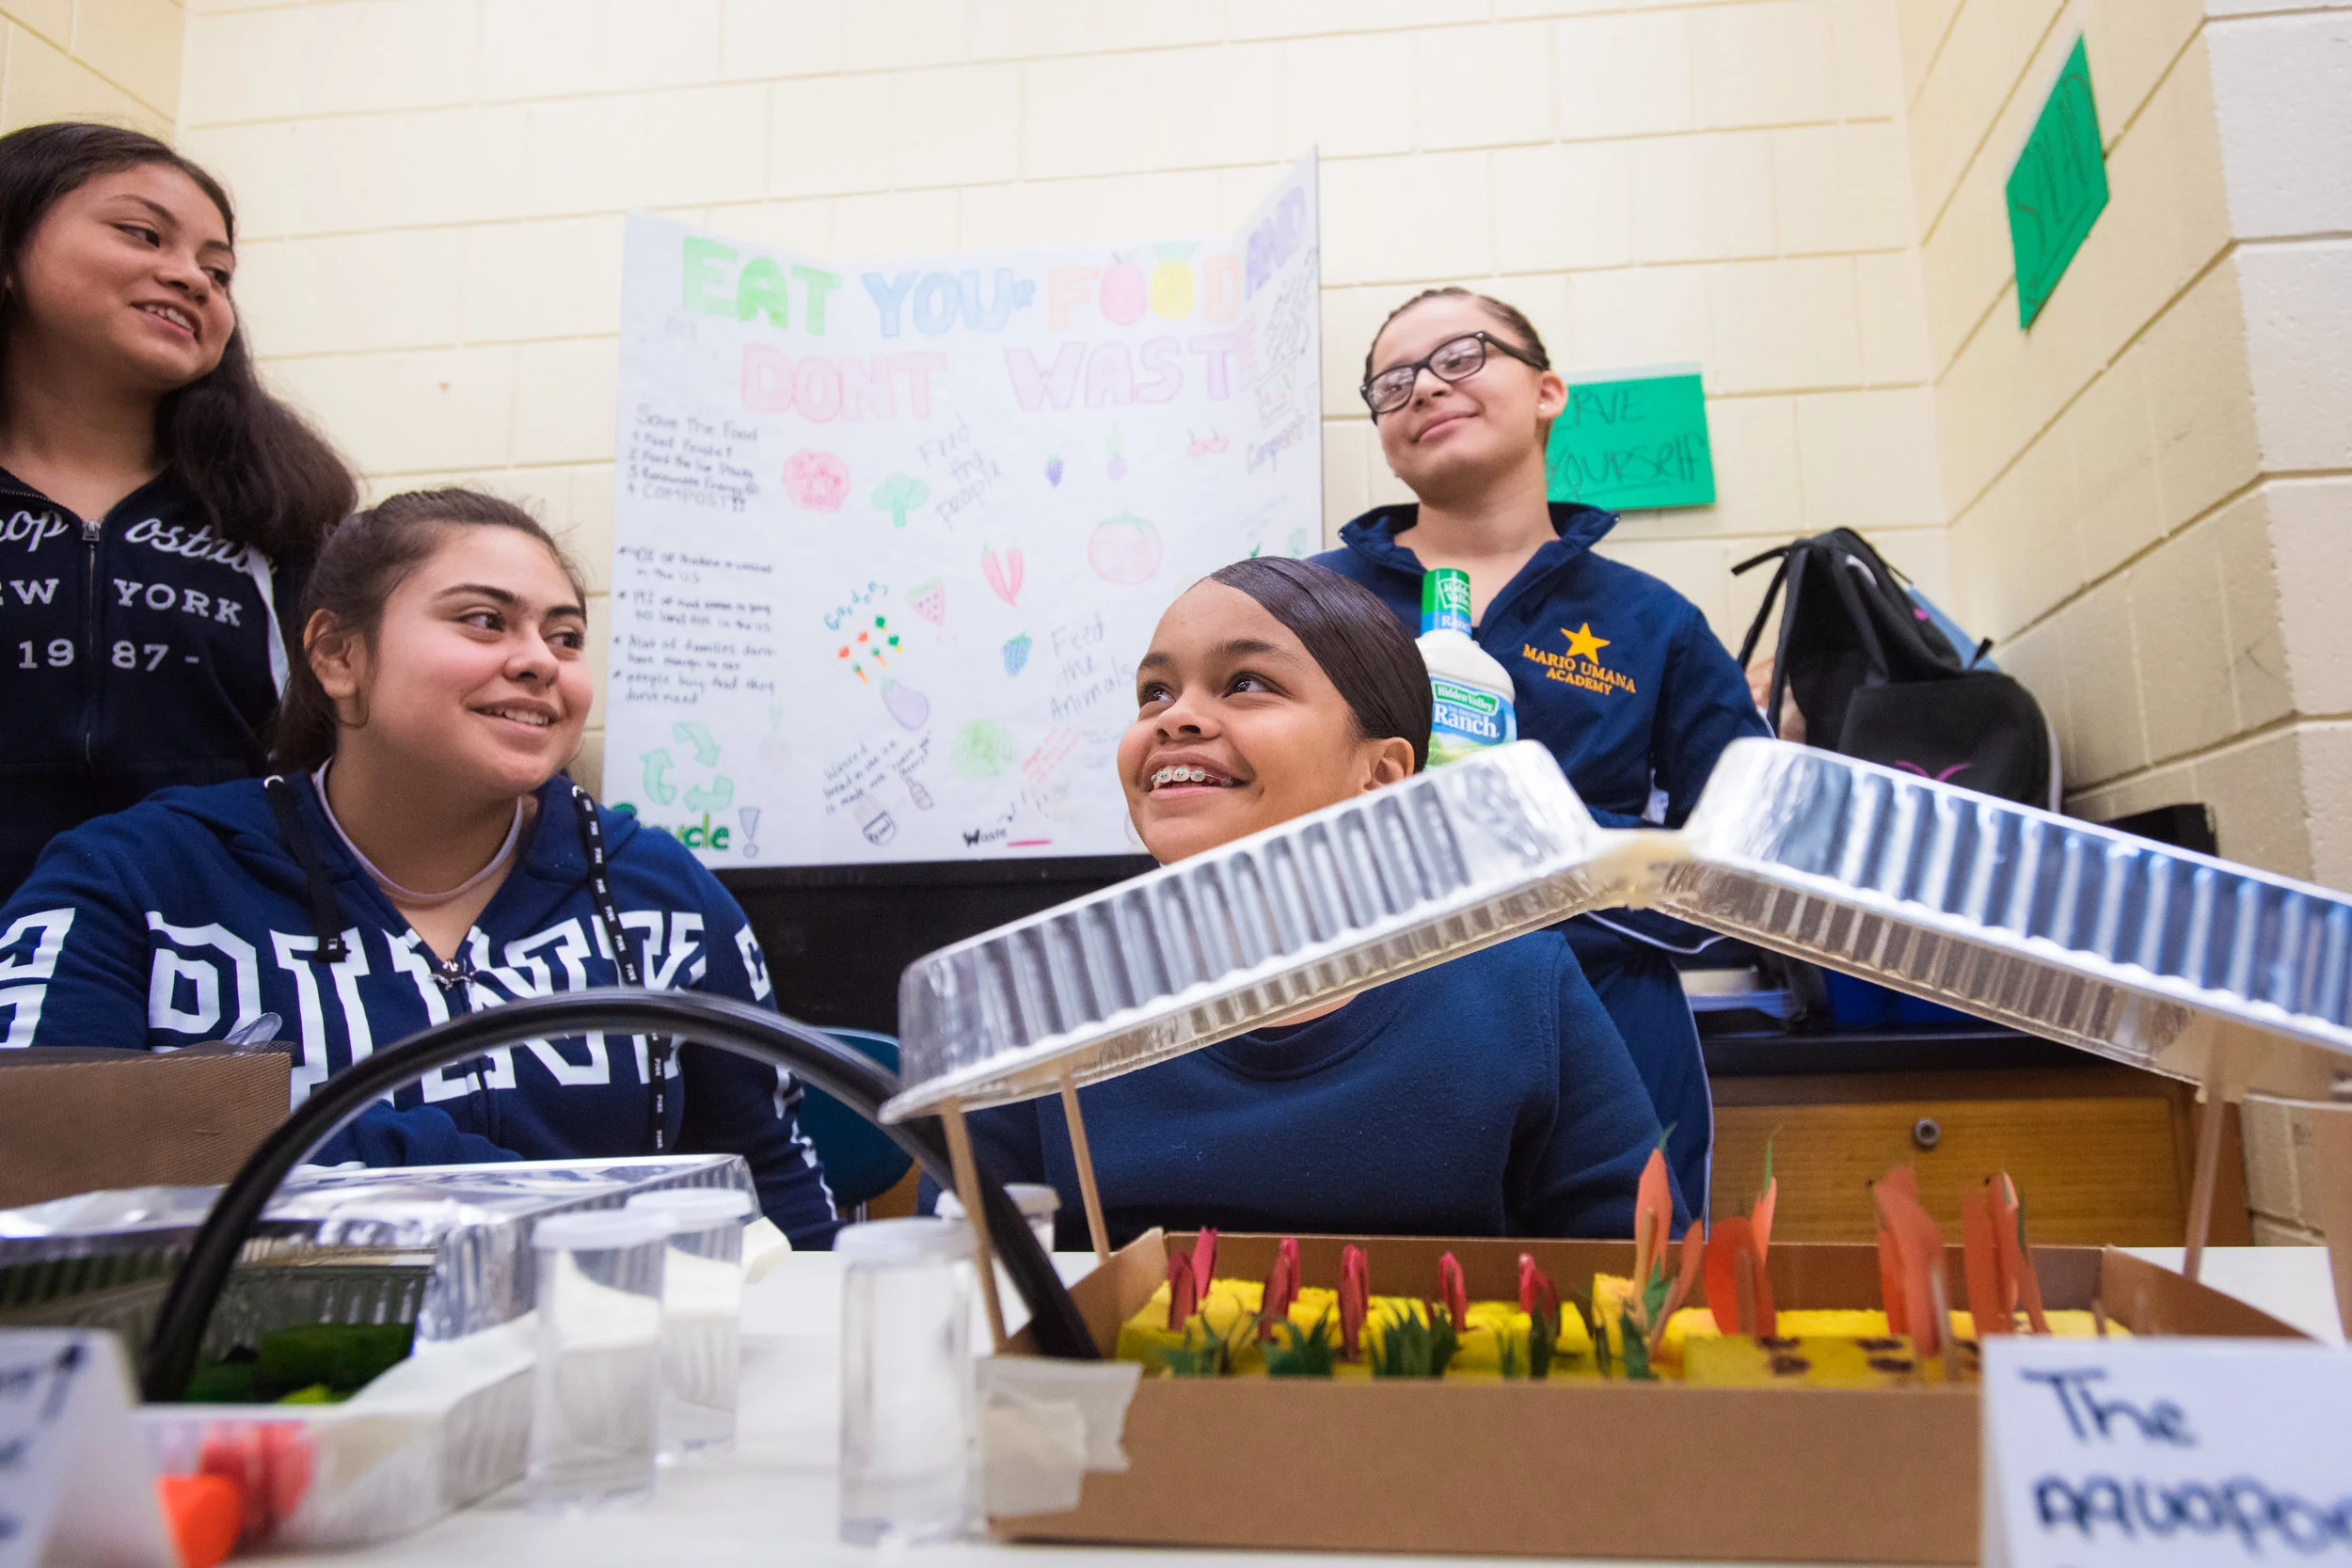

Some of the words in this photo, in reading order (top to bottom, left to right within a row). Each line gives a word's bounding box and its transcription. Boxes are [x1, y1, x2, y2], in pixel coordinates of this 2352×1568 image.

[682, 236, 842, 336] EAT
[1048, 246, 1242, 331] FOOD
[741, 342, 947, 423] DONT
[1003, 312, 1257, 412] WASTE
[635, 404, 678, 429] Save
[723, 420, 758, 440] Food
[113, 578, 243, 626] YORK
[1050, 612, 1104, 658] Feed
[1441, 615, 1472, 633] Ranc
[19, 638, 75, 670] 19
[1059, 653, 1099, 689] the
[1522, 643, 1577, 672] MARIO
[1581, 661, 1637, 694] UMANA
[1049, 653, 1135, 721] Animals
[1437, 686, 1468, 703] Hidden
[1469, 693, 1495, 714] Valley
[1546, 667, 1613, 696] ACADEMY
[1435, 704, 1498, 739] Ranch
[2019, 1367, 2199, 1448] The
